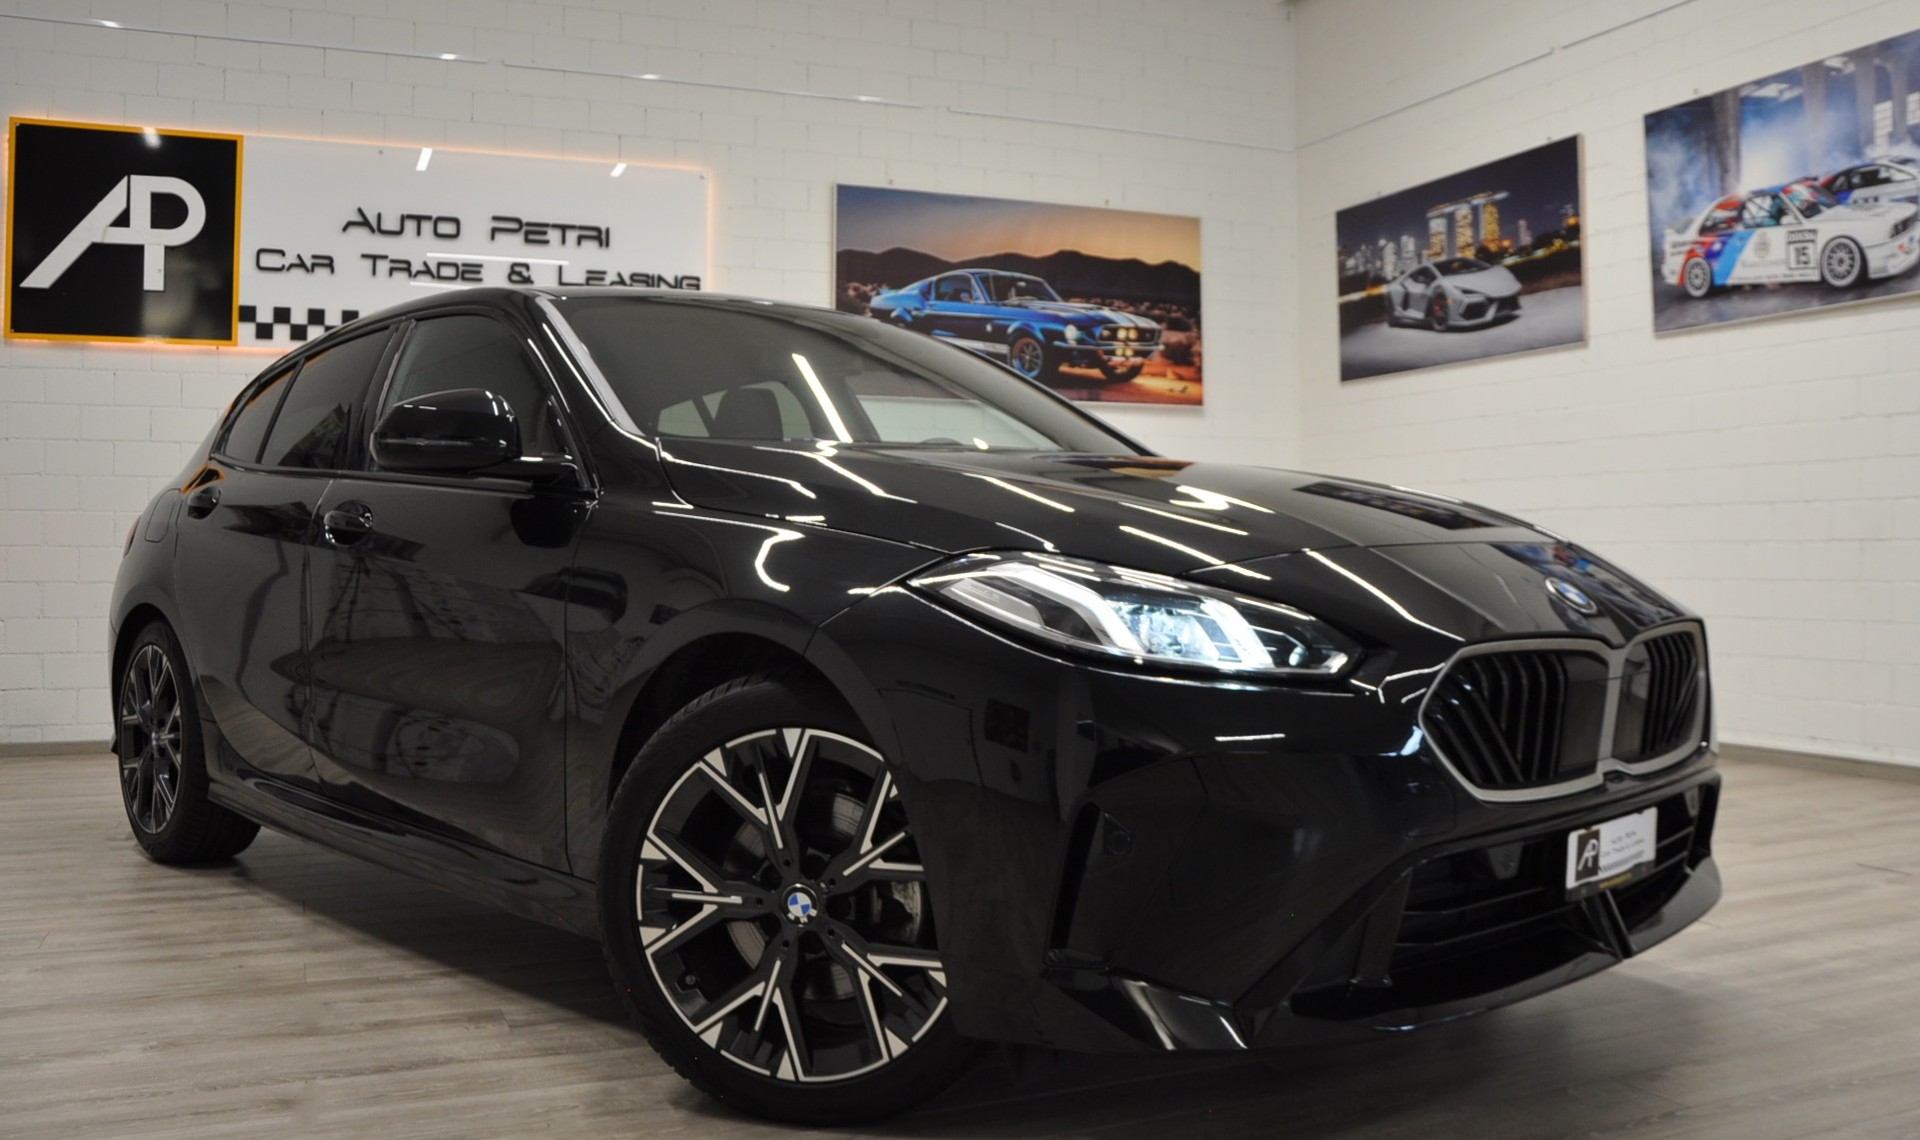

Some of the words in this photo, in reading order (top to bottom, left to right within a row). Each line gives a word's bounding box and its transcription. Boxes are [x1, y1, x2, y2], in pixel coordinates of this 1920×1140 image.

[19, 174, 207, 292] AP
[341, 206, 461, 239] AUTO
[490, 215, 610, 249] PETRI
[255, 247, 335, 275] CAR
[360, 252, 484, 282] TRADE
[507, 262, 535, 285] &
[557, 264, 702, 291] LEASING
